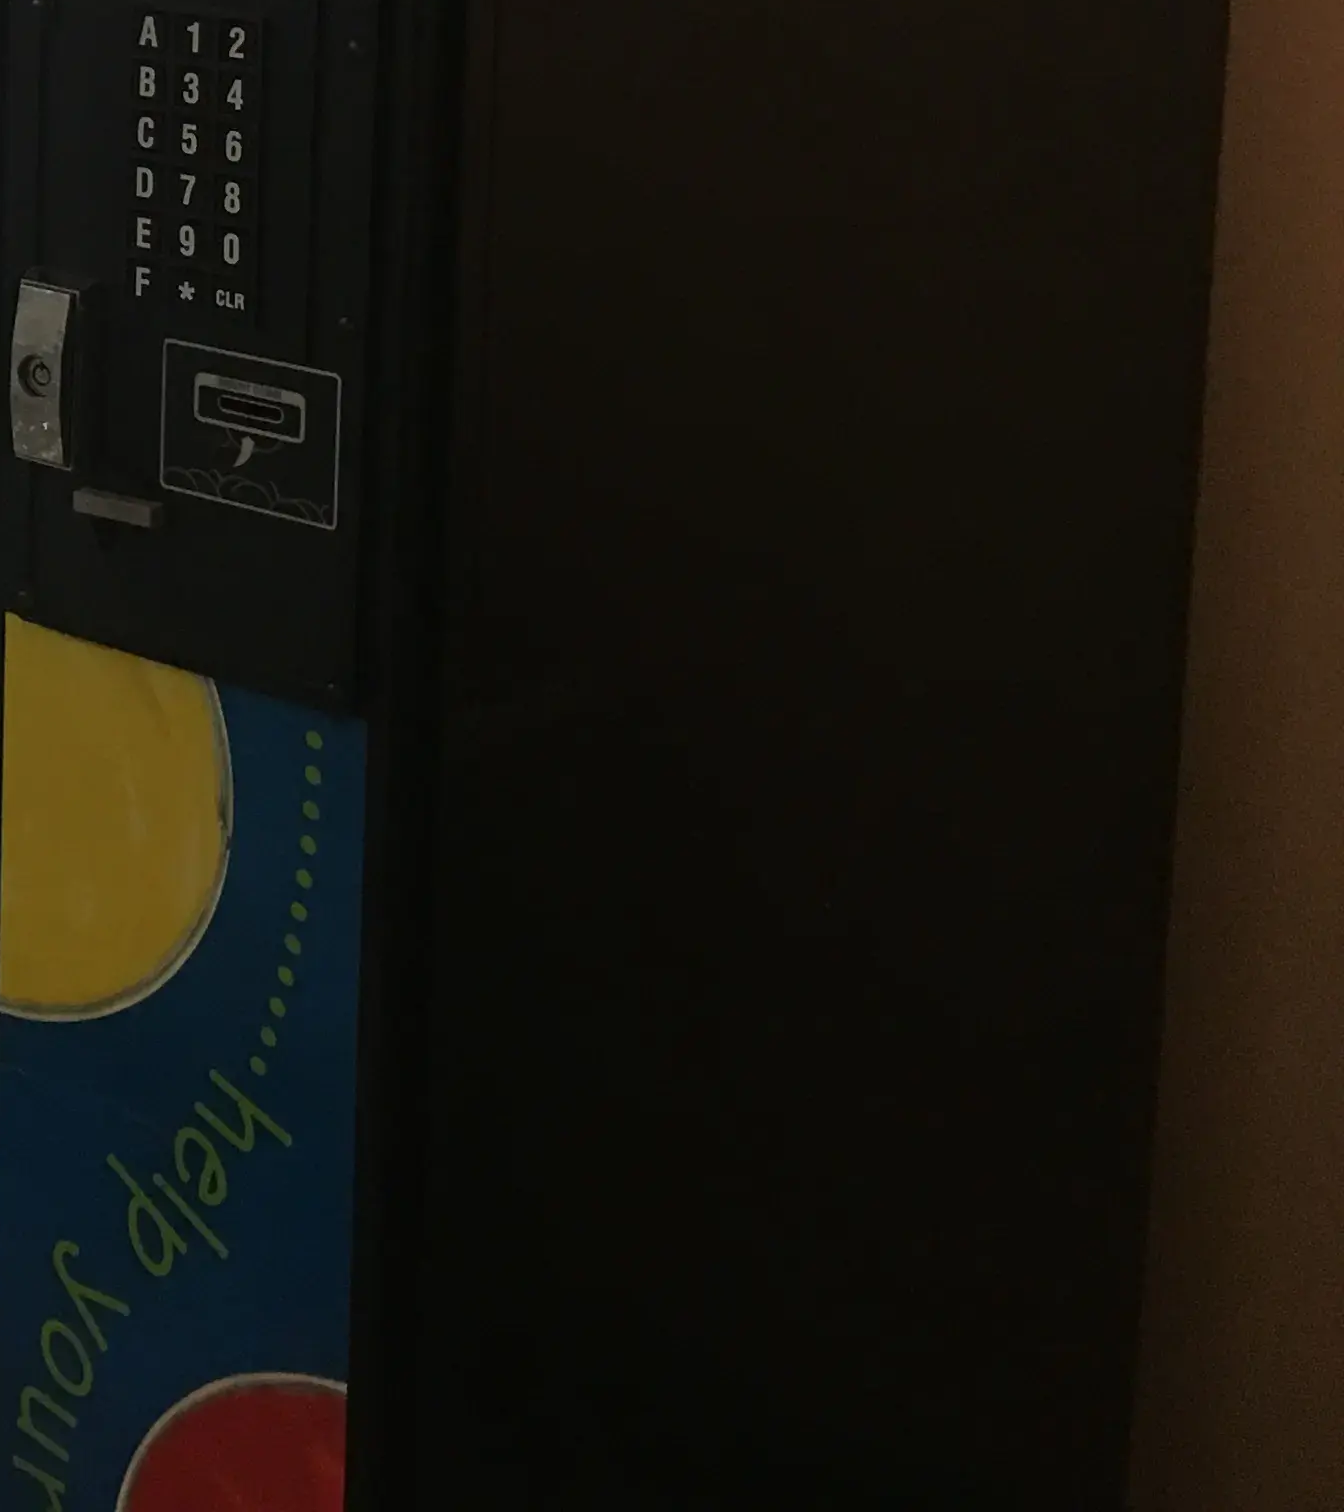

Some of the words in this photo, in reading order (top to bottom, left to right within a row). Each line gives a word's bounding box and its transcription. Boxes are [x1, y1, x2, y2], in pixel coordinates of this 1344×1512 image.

[138, 16, 158, 47] A
[187, 21, 200, 53] 1
[228, 27, 245, 59] 2
[139, 66, 156, 97] B
[183, 72, 199, 104] 3
[226, 79, 244, 111] 4
[137, 116, 155, 149] C
[181, 123, 198, 155] 5
[225, 130, 242, 162] 6
[136, 166, 154, 198] D
[179, 173, 196, 205] 7
[224, 181, 241, 214] 8
[136, 217, 151, 249] E
[179, 224, 195, 257] 9
[223, 232, 240, 265] 0
[135, 266, 151, 297] F
[216, 289, 245, 311] CLR
[106, 1069, 293, 1278] help
[12, 1239, 132, 1512] your
